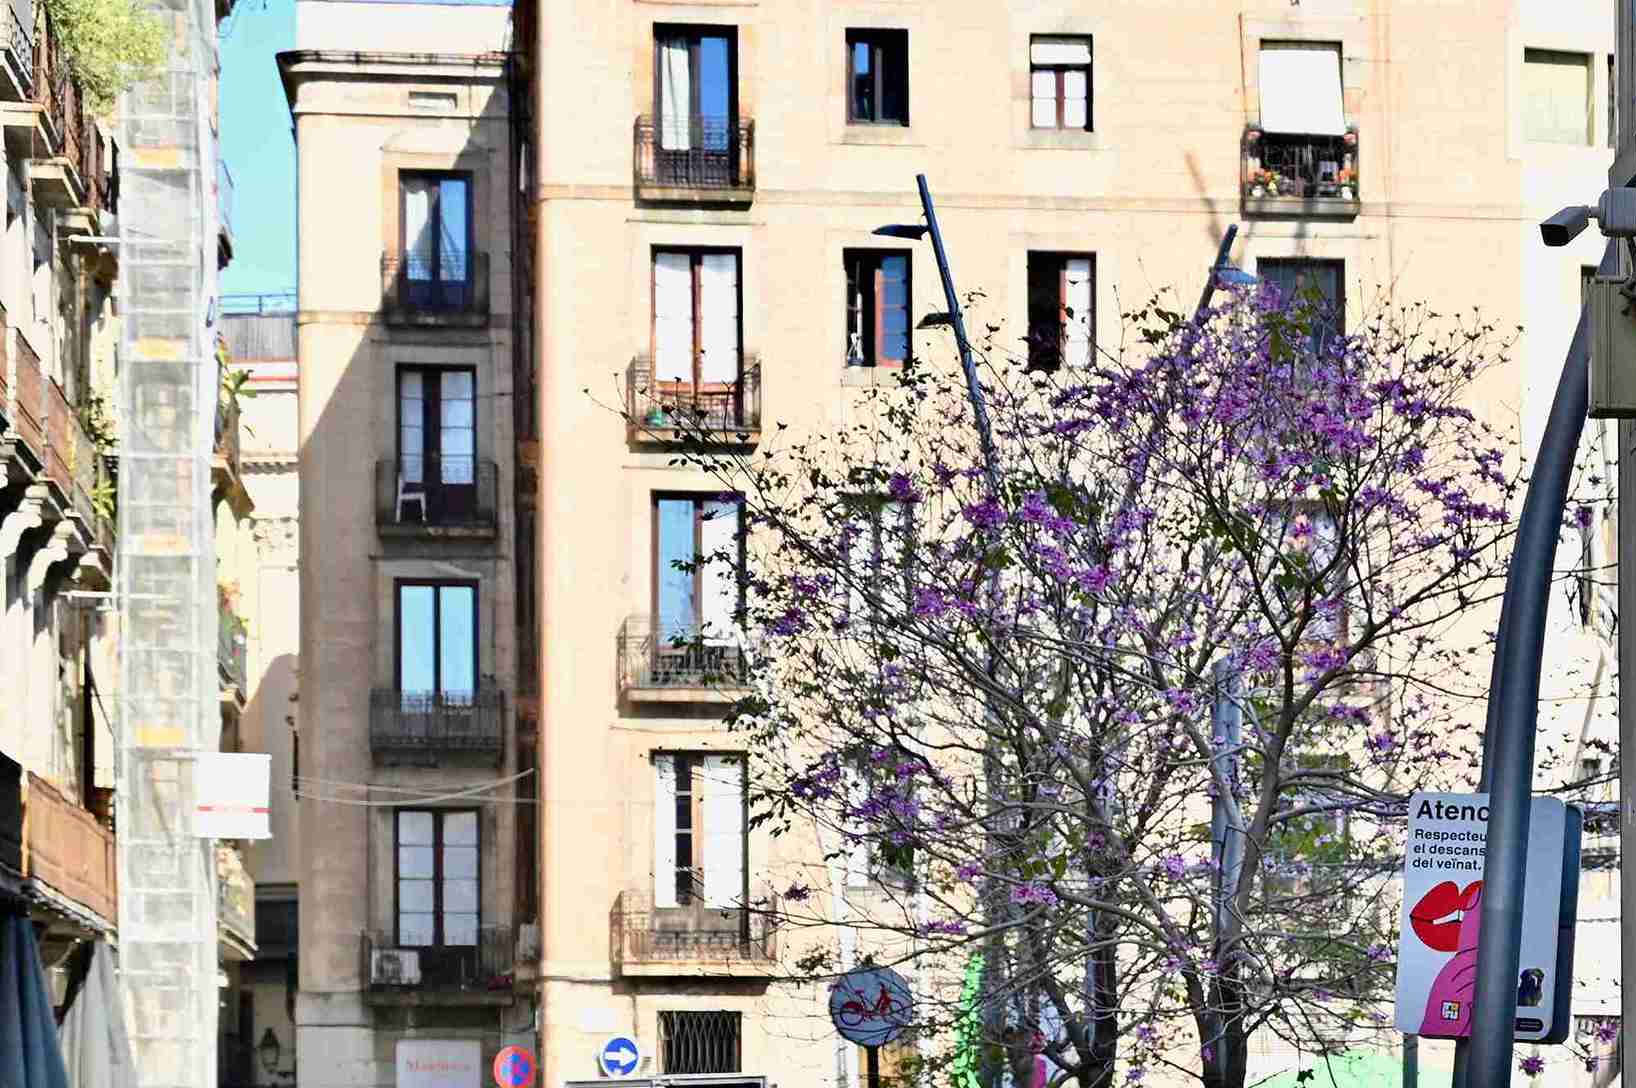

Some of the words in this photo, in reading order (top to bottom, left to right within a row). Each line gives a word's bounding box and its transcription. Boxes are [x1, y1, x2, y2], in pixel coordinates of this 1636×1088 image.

[1416, 799, 1489, 821] Atenc
[1415, 828, 1487, 842] Respecteu
[1413, 843, 1426, 854] el
[1429, 844, 1488, 856] descans
[1412, 857, 1433, 868] del
[1437, 858, 1482, 871] veïnat.
